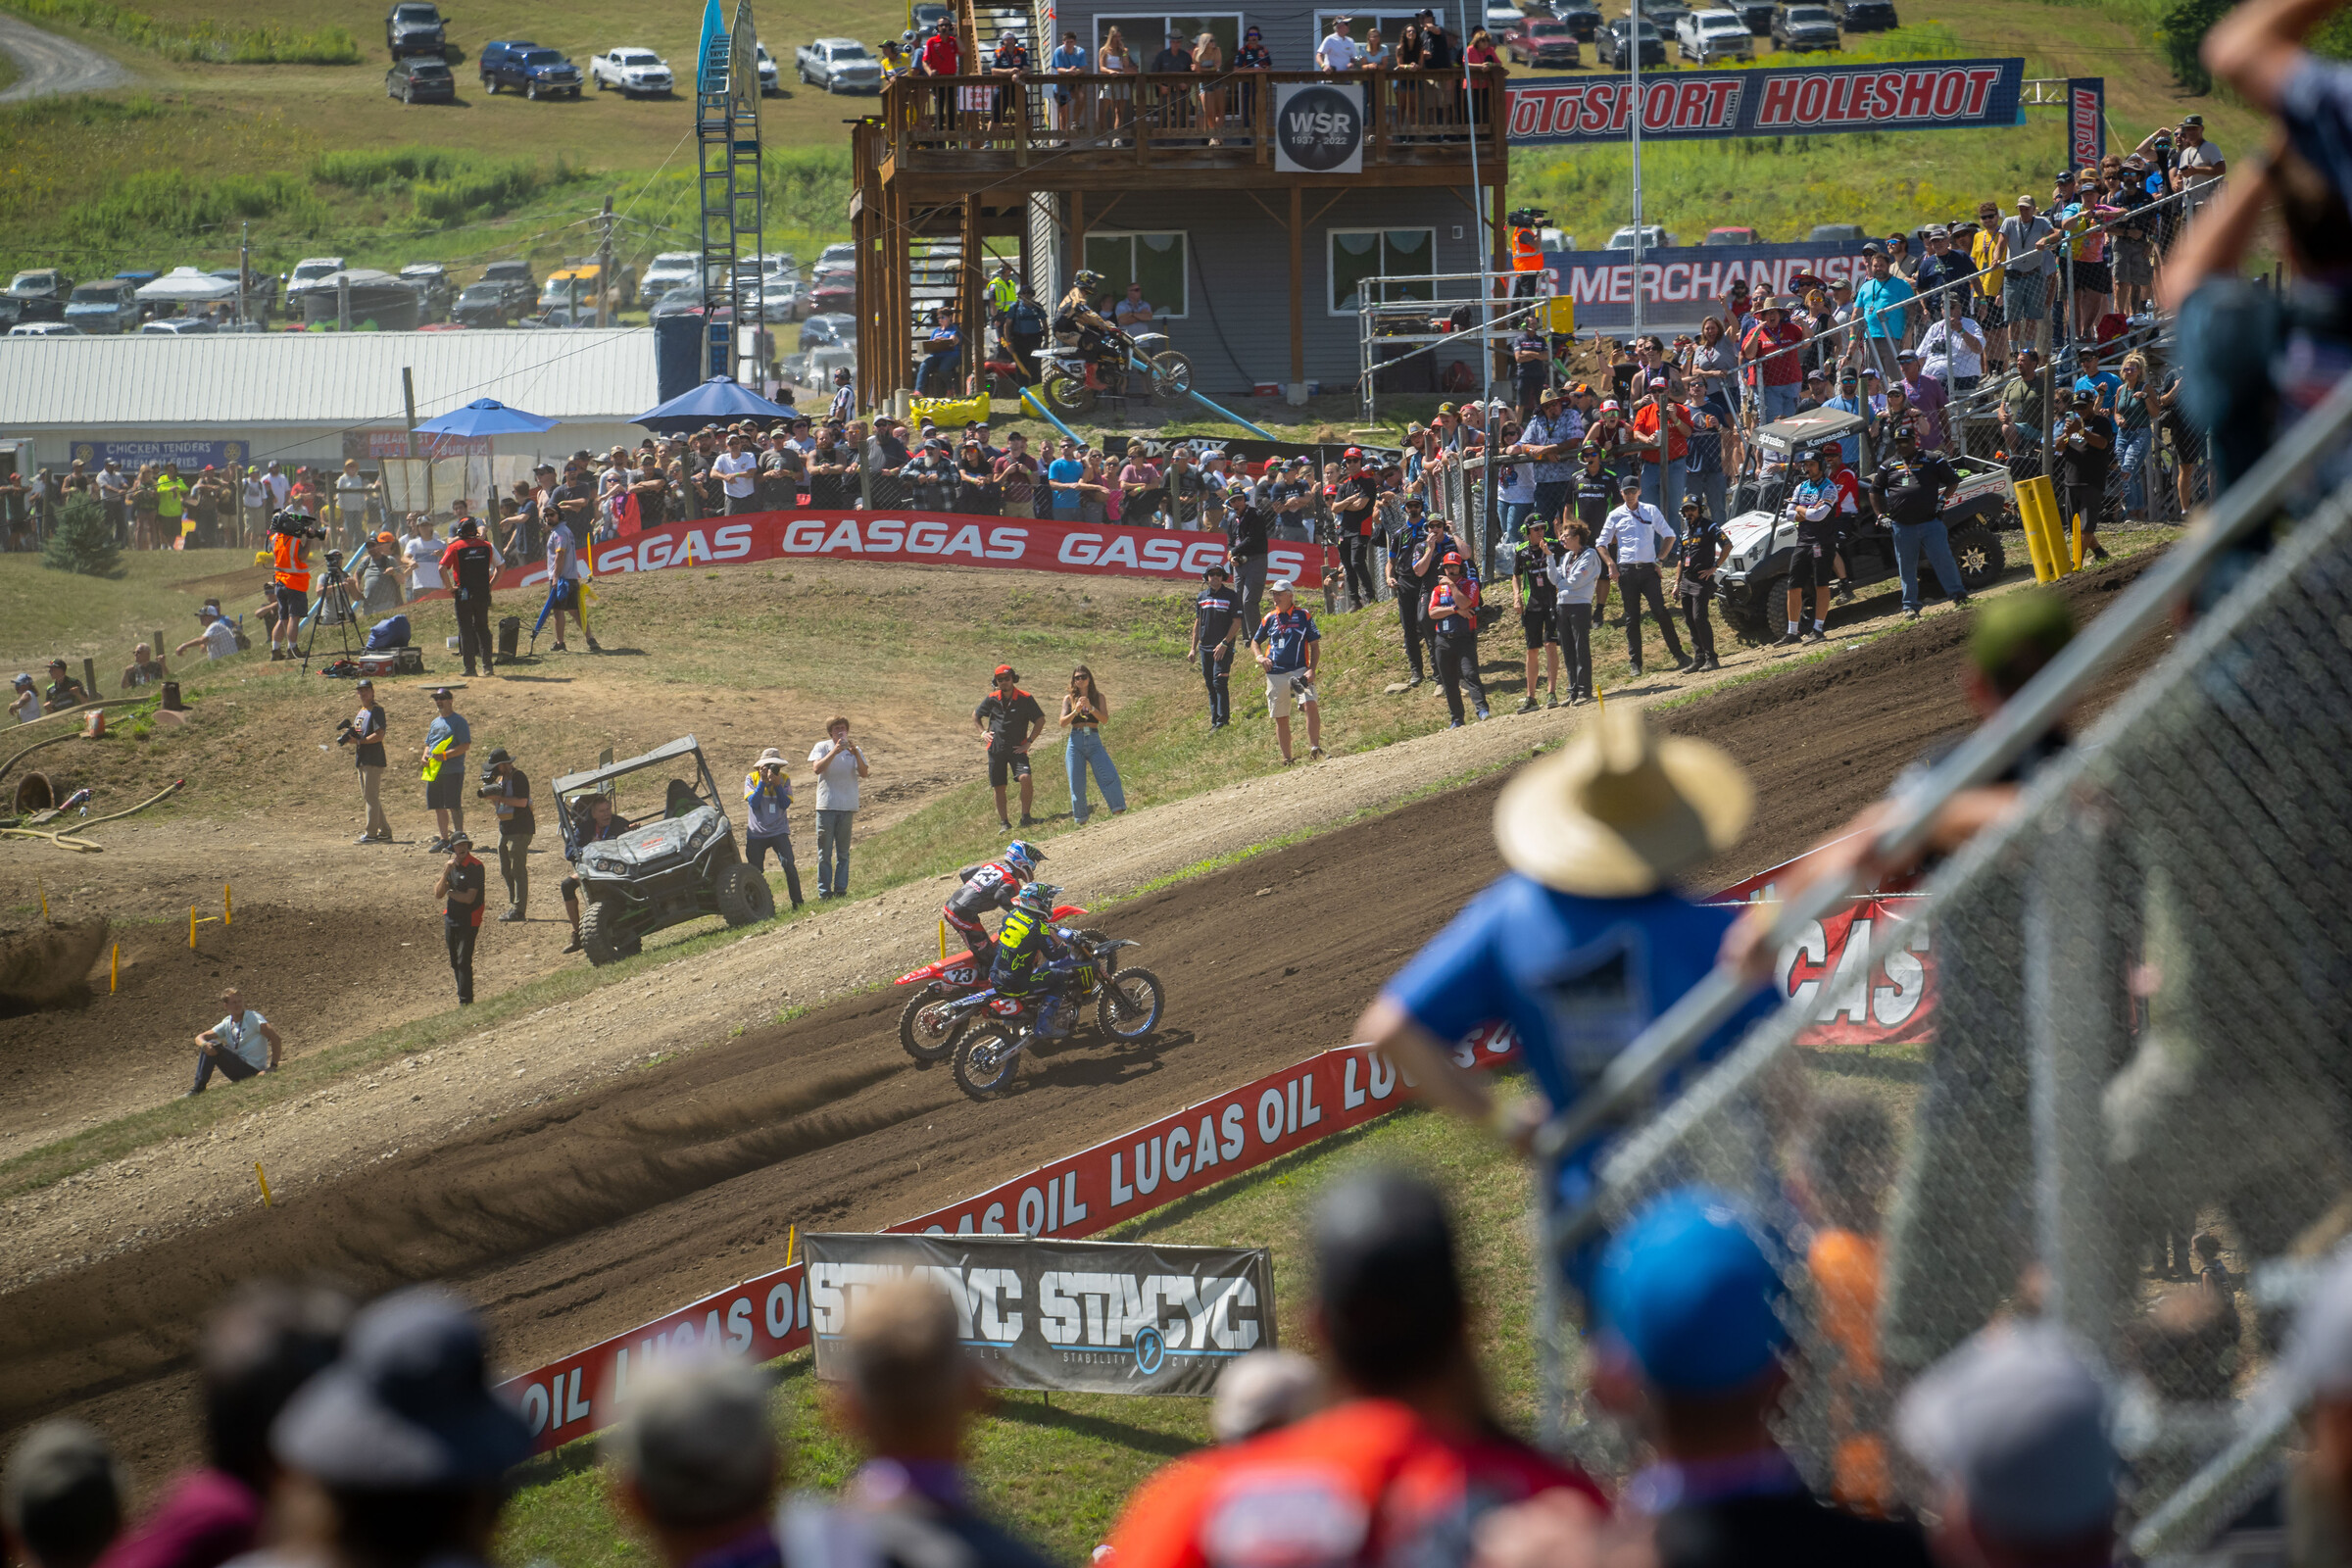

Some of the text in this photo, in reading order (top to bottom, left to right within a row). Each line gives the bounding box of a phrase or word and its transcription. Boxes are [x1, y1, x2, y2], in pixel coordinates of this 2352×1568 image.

[1757, 68, 2000, 125] HOLESHOT
[1289, 112, 1351, 134] WSR
[2074, 88, 2097, 170] MOTOSP
[1292, 136, 1314, 145] 1937
[1323, 136, 1348, 145] 2022
[369, 432, 430, 445] BREAKST
[1806, 426, 1851, 448] Kawasaki
[106, 442, 212, 455] CHICKEN TENDERS
[171, 457, 198, 468] FRIES
[520, 519, 1305, 587] SGAS GASGAS GASGS
[972, 864, 1004, 887] 23
[1000, 917, 1030, 949] 3
[952, 968, 974, 983] 23
[1774, 917, 1931, 1027] CAS
[1000, 998, 1018, 1015] 3
[1017, 1170, 1088, 1237] OIL
[1109, 1102, 1246, 1208] LUCAS
[1256, 1072, 1322, 1145] OIL
[1344, 1027, 1485, 1112] LUS
[809, 1261, 1260, 1350] STYC STACYC
[520, 1366, 591, 1439] OIL
[764, 1277, 809, 1340] OI
[1063, 1352, 1233, 1369] STABILITY CYCLE
